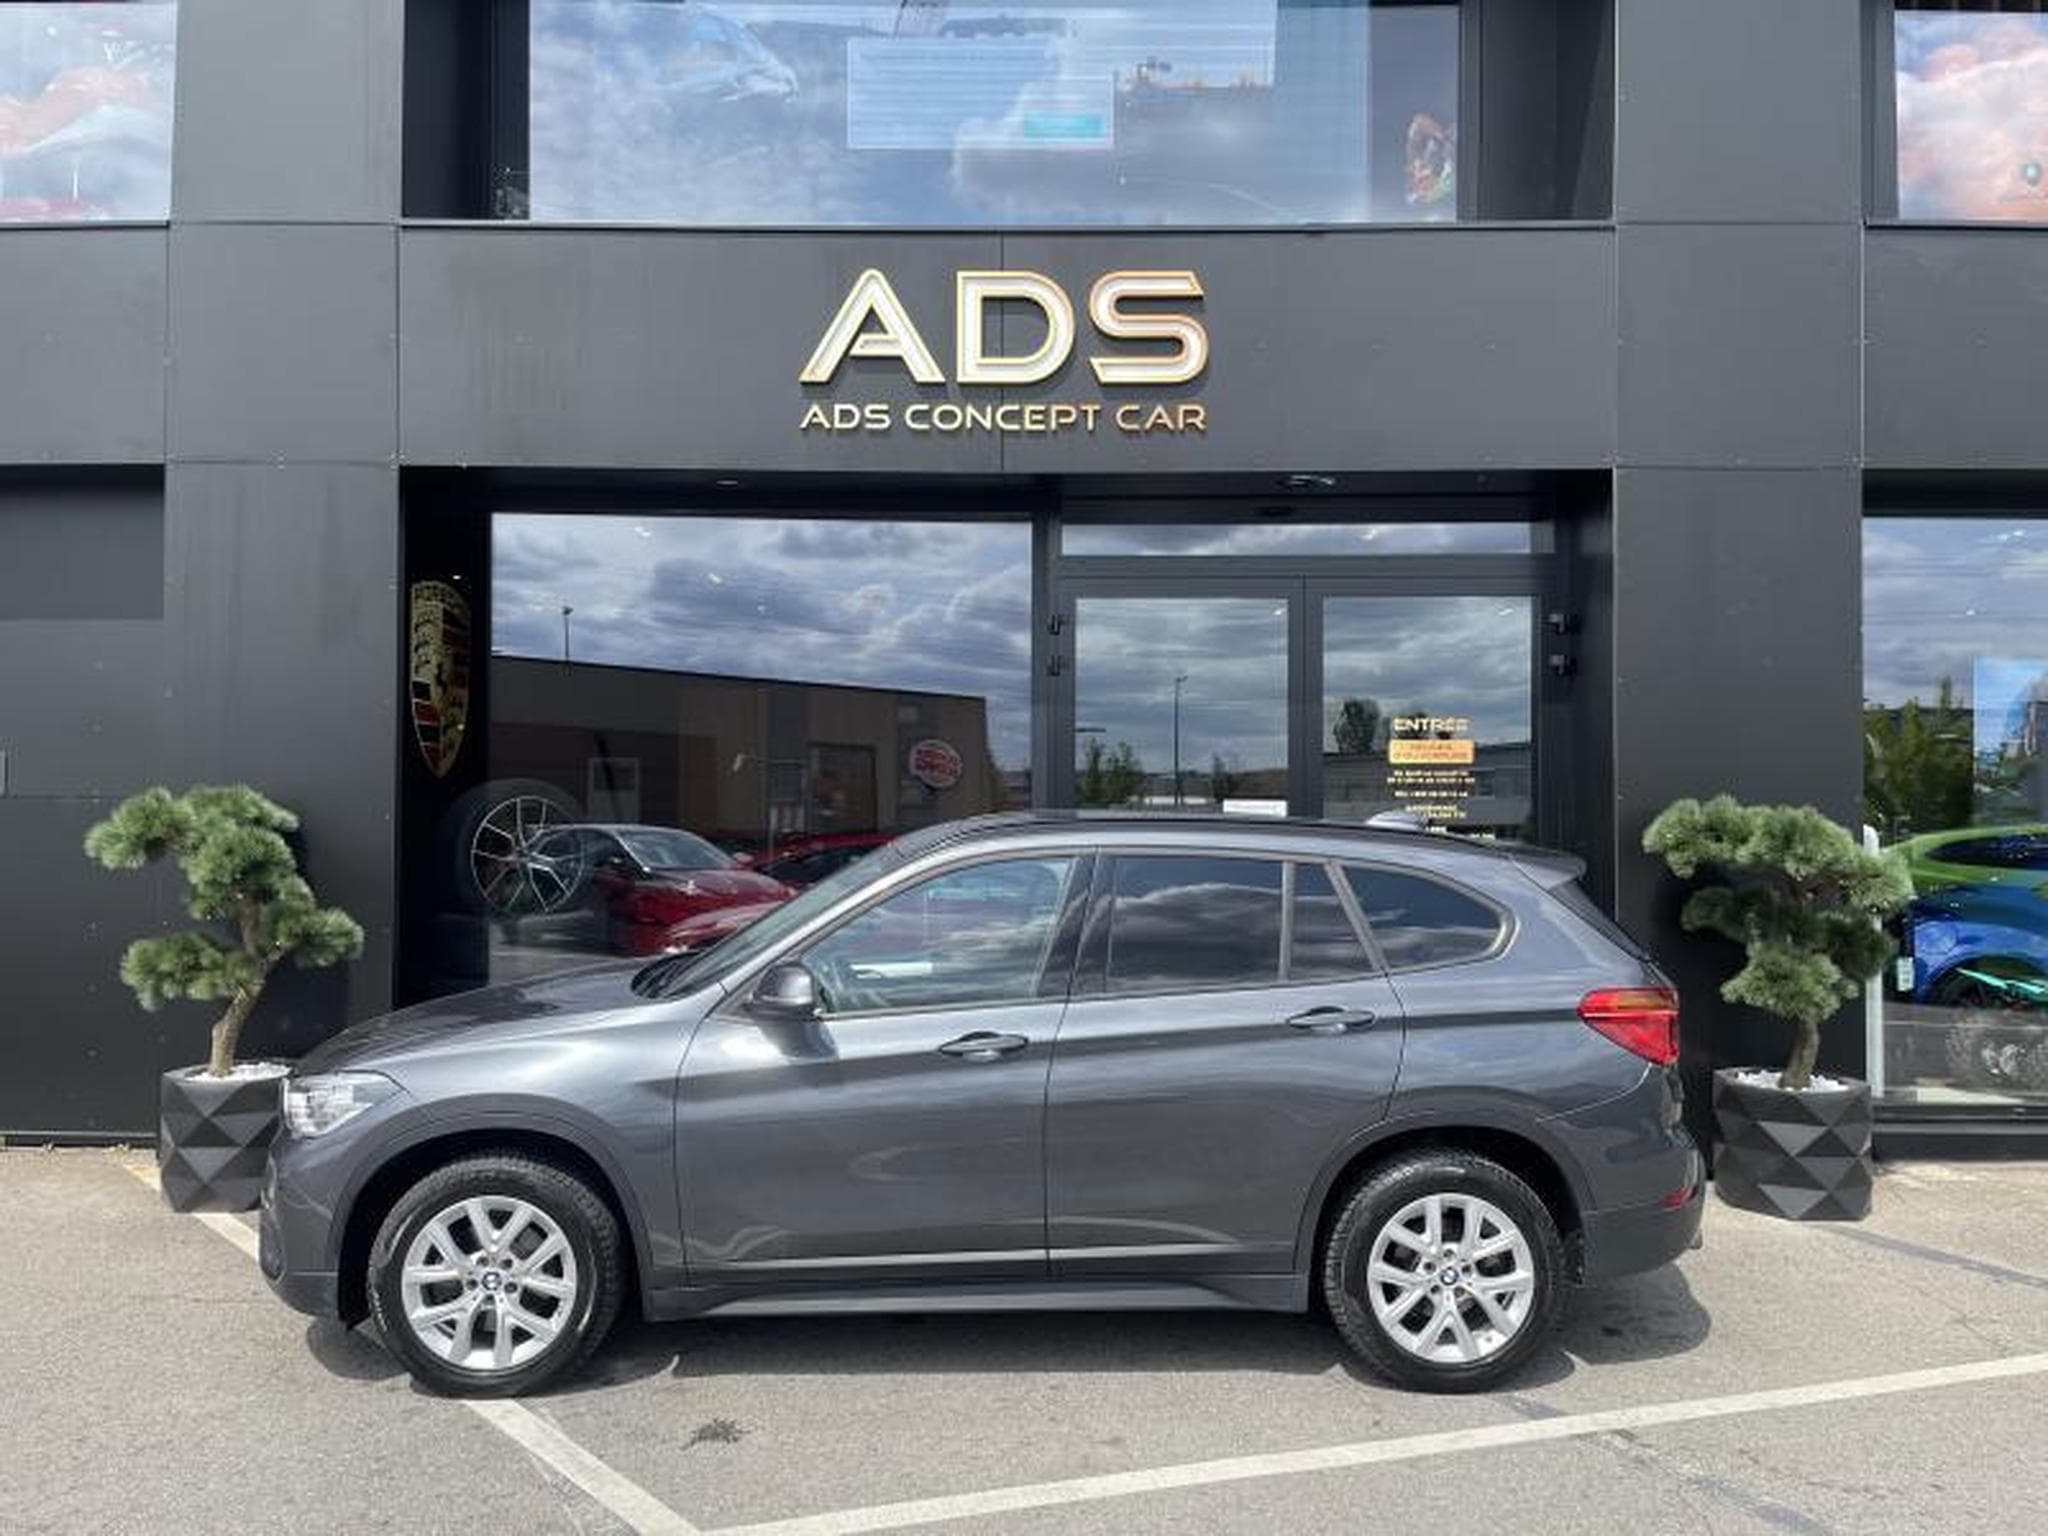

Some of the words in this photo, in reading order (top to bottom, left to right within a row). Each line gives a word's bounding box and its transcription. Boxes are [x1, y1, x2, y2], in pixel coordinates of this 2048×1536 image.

[799, 268, 1209, 384] ADS
[800, 404, 891, 431] ADS
[904, 404, 1101, 431] CONCEPT
[1115, 404, 1207, 431] CAR
